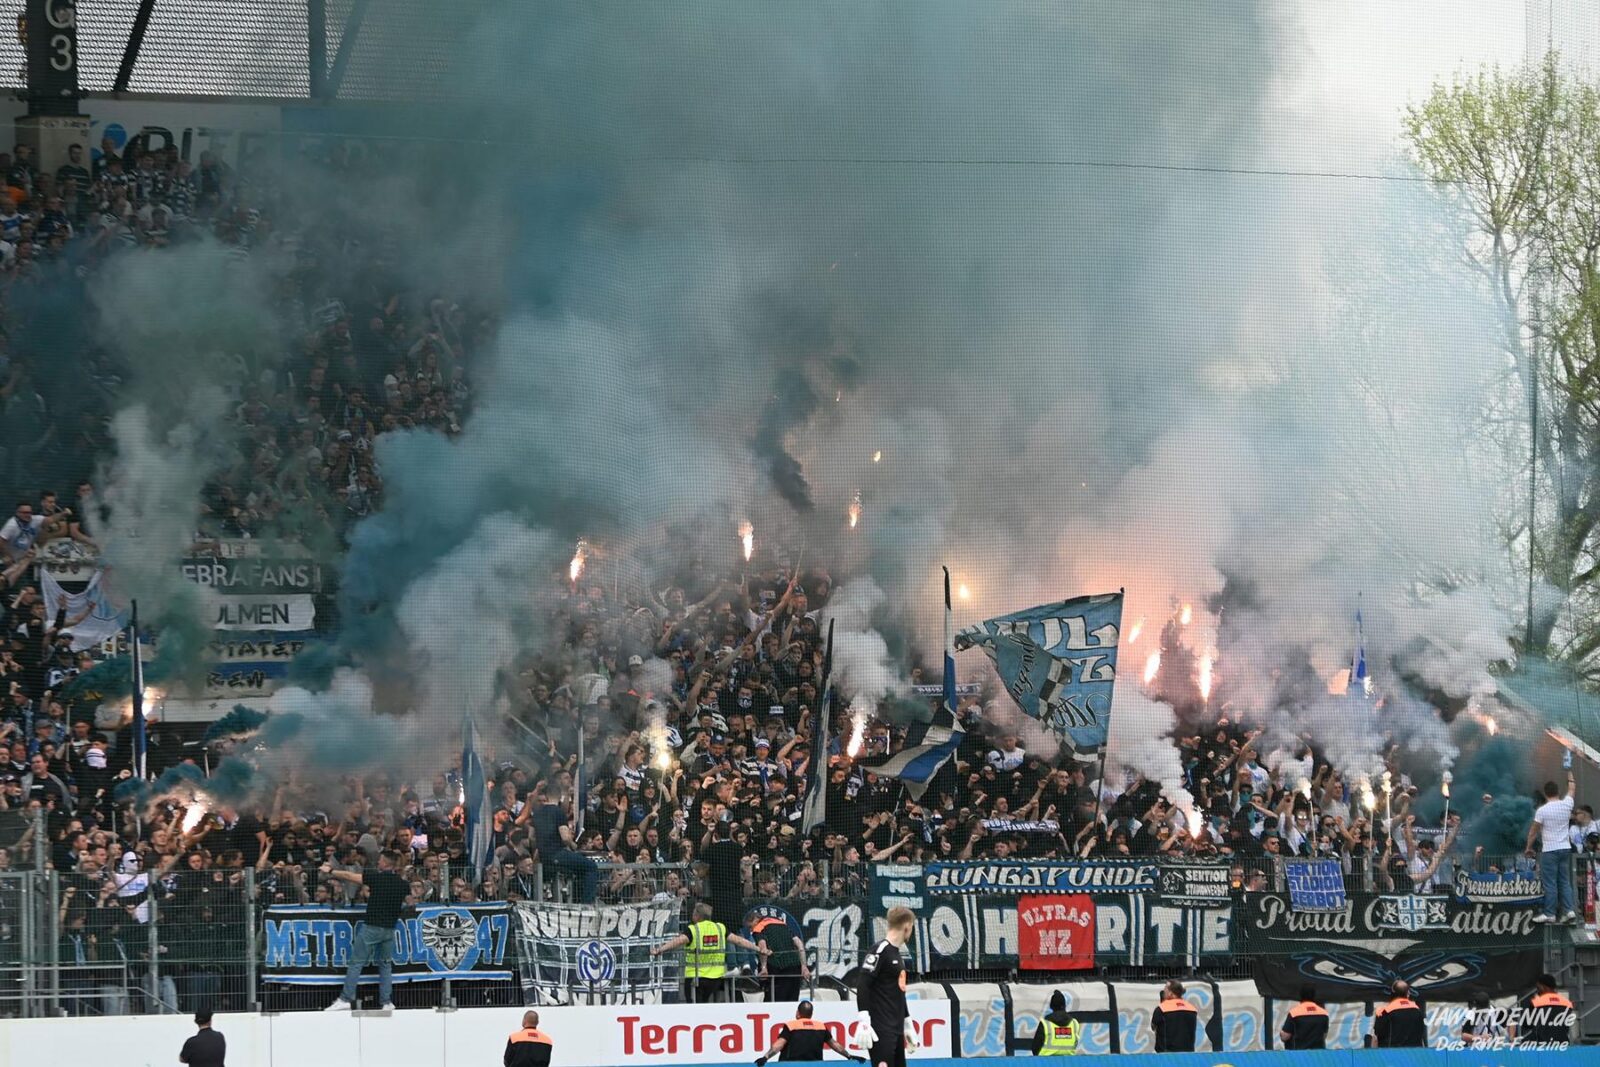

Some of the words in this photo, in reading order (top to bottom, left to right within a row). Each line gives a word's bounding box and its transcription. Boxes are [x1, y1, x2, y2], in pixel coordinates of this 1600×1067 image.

[50, 34, 72, 71] 3
[1455, 871, 1544, 897] Freundeskrei
[517, 908, 671, 939] RUHRPOTT
[1021, 904, 1091, 927] ULTRAS
[1256, 895, 1355, 933] Proud
[265, 919, 429, 968] METROL
[476, 914, 509, 966] 47
[1038, 929, 1072, 955] MZ
